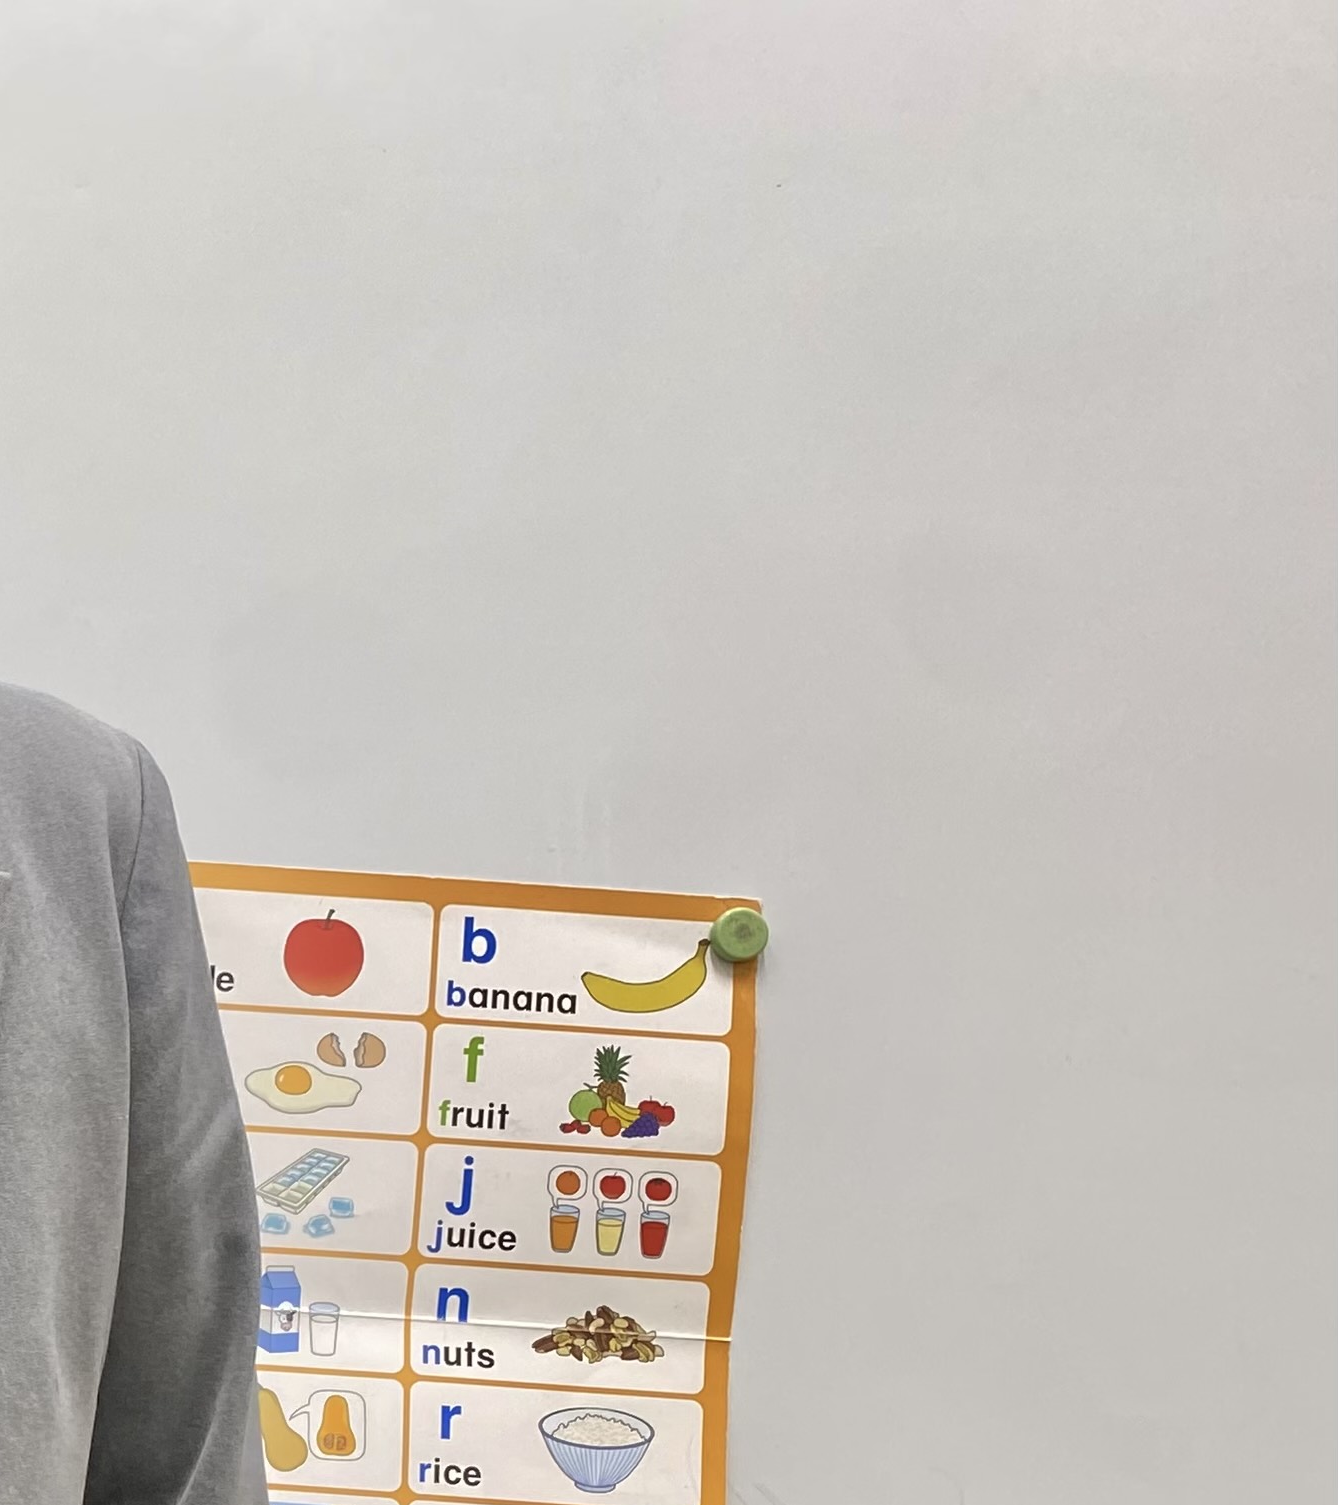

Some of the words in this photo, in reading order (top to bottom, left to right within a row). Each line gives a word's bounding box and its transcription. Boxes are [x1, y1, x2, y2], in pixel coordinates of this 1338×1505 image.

[461, 916, 498, 964] b
[446, 980, 577, 1015] banana
[462, 1036, 486, 1084] f
[438, 1099, 510, 1131] fruit
[444, 1155, 475, 1216] j
[426, 1218, 518, 1254] juice
[436, 1286, 470, 1323] n
[422, 1341, 496, 1370] nuts
[440, 1404, 462, 1440] r
[418, 1457, 482, 1487] rice
